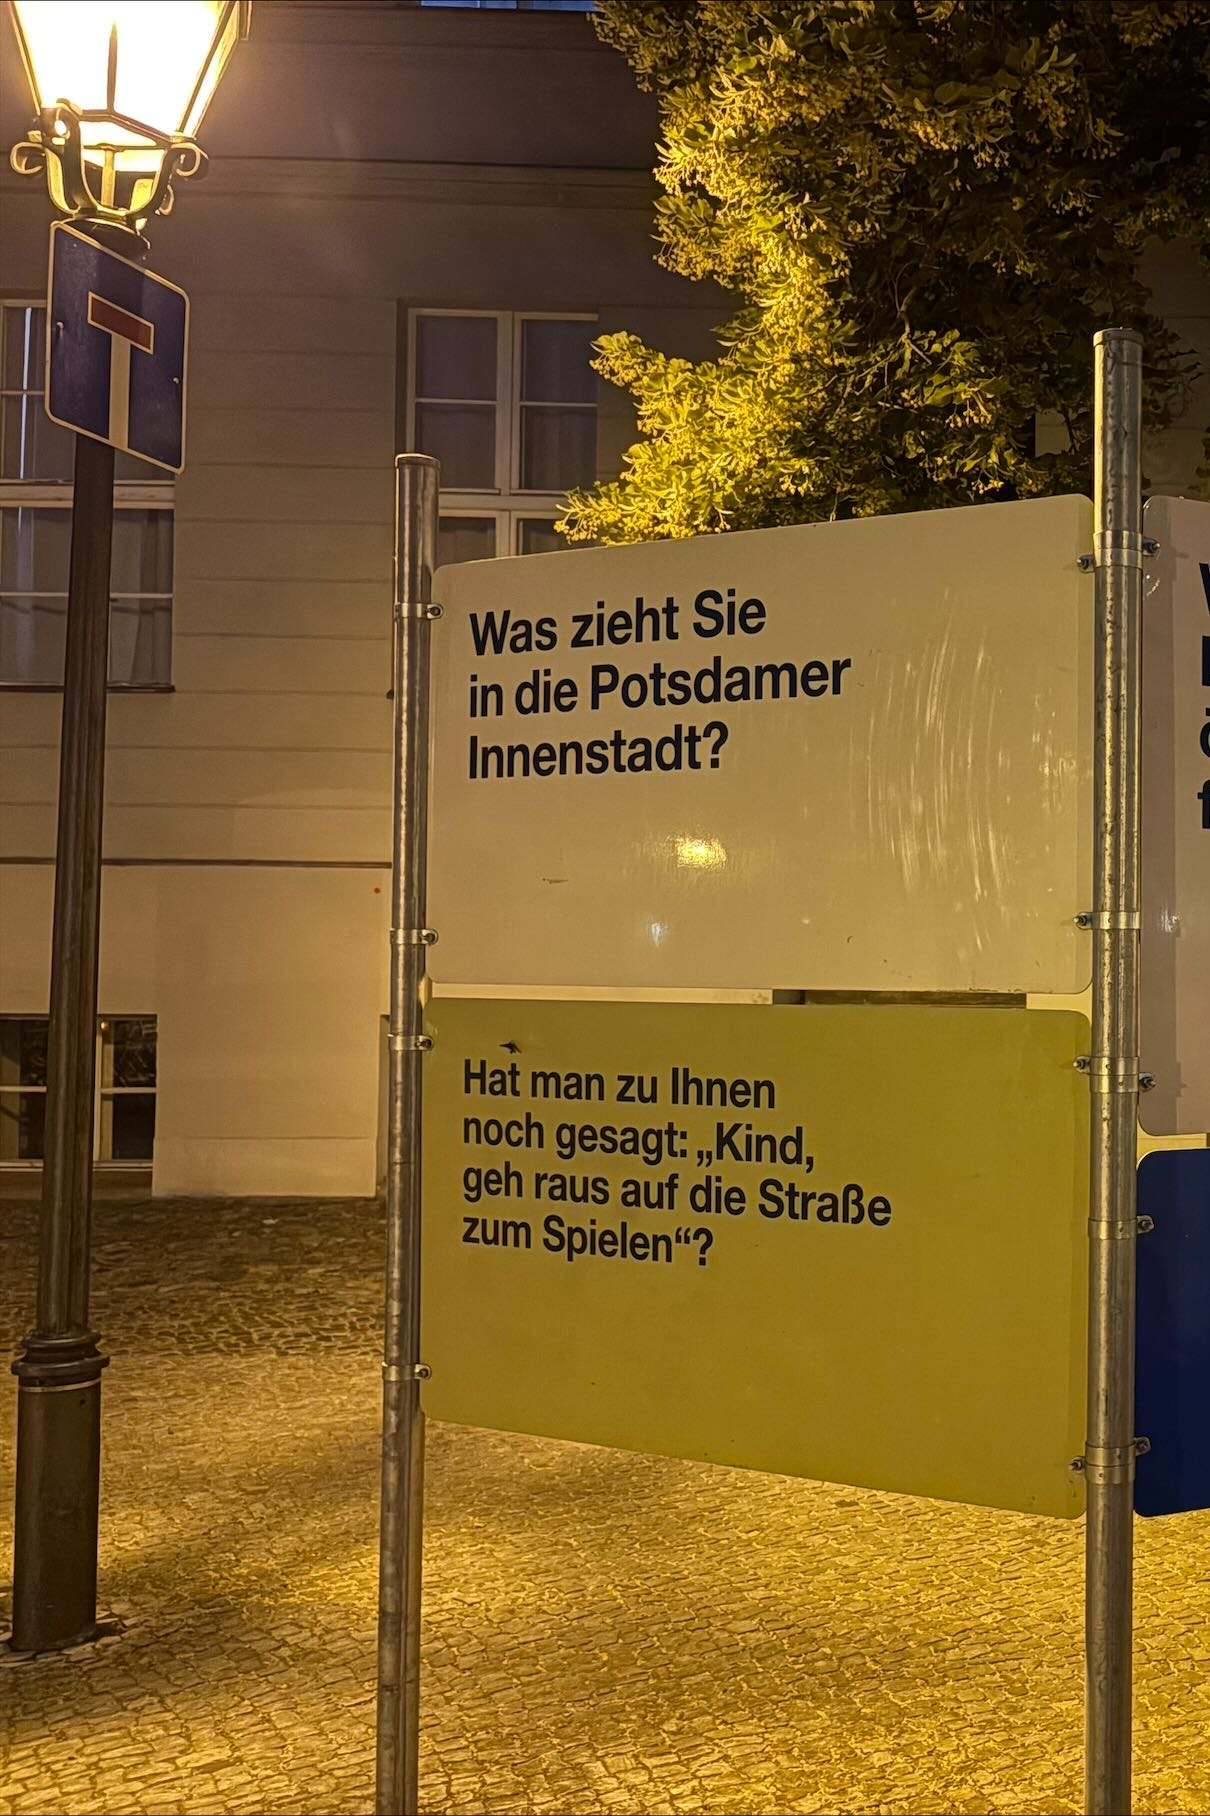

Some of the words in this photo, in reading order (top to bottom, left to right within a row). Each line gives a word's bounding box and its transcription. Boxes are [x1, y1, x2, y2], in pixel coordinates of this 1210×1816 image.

[469, 610, 557, 656] Was
[571, 597, 679, 648] zieht
[693, 589, 766, 638] Sie
[470, 674, 503, 717] in
[515, 669, 578, 715] die
[591, 656, 851, 710] Potsdamer
[470, 721, 728, 779] Innenstadt?
[465, 1059, 520, 1096] Hat
[532, 1072, 604, 1100] man
[616, 1075, 657, 1103] zu
[672, 1068, 774, 1108] Ihnen
[464, 1112, 543, 1148] noch
[556, 1122, 687, 1165] gesagt:
[463, 1161, 522, 1202] geh
[535, 1173, 609, 1204] raus
[621, 1173, 679, 1210] auf
[690, 1175, 746, 1215] die
[759, 1179, 891, 1226] Straße
[463, 1217, 531, 1248] zum
